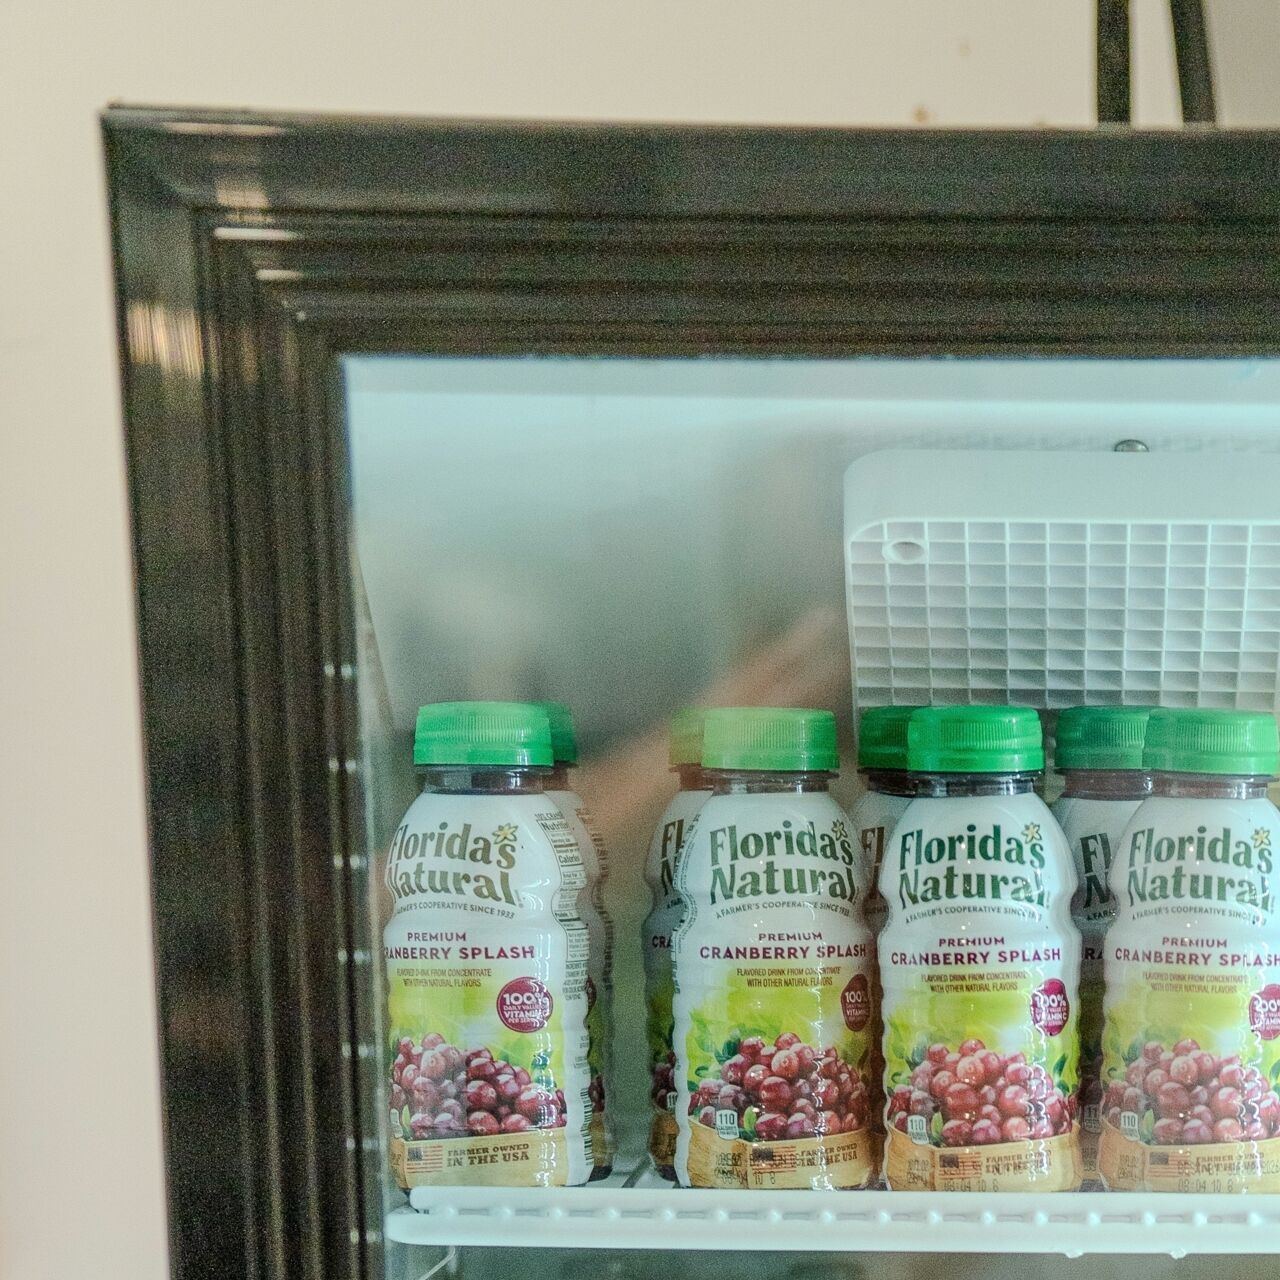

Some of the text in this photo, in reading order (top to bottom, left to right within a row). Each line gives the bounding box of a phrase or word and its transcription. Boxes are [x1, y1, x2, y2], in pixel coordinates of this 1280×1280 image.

[710, 820, 855, 867] Florida's
[900, 824, 1046, 871] Florida's
[1128, 826, 1273, 874] Florida's
[710, 861, 856, 906] Natural
[900, 866, 1046, 910] Natural
[1128, 866, 1271, 912] Natural
[419, 901, 468, 911] COOPERATIVE
[470, 905, 495, 915] SINCE
[407, 932, 467, 942] PREMIUM
[758, 932, 823, 942] PREMIUM
[938, 937, 1005, 947] PREMIUM
[1162, 937, 1227, 947] PREMIUM
[700, 944, 866, 960] CRANBERRY SPLASH
[891, 949, 1061, 966] CRANBERRY SPLASH
[1115, 948, 1212, 965] CRANBERRY
[718, 1113, 735, 1125] 110
[1123, 1115, 1136, 1126] 110
[448, 1143, 530, 1156] FARMER OWNED
[447, 1151, 530, 1168] IN THE USA
